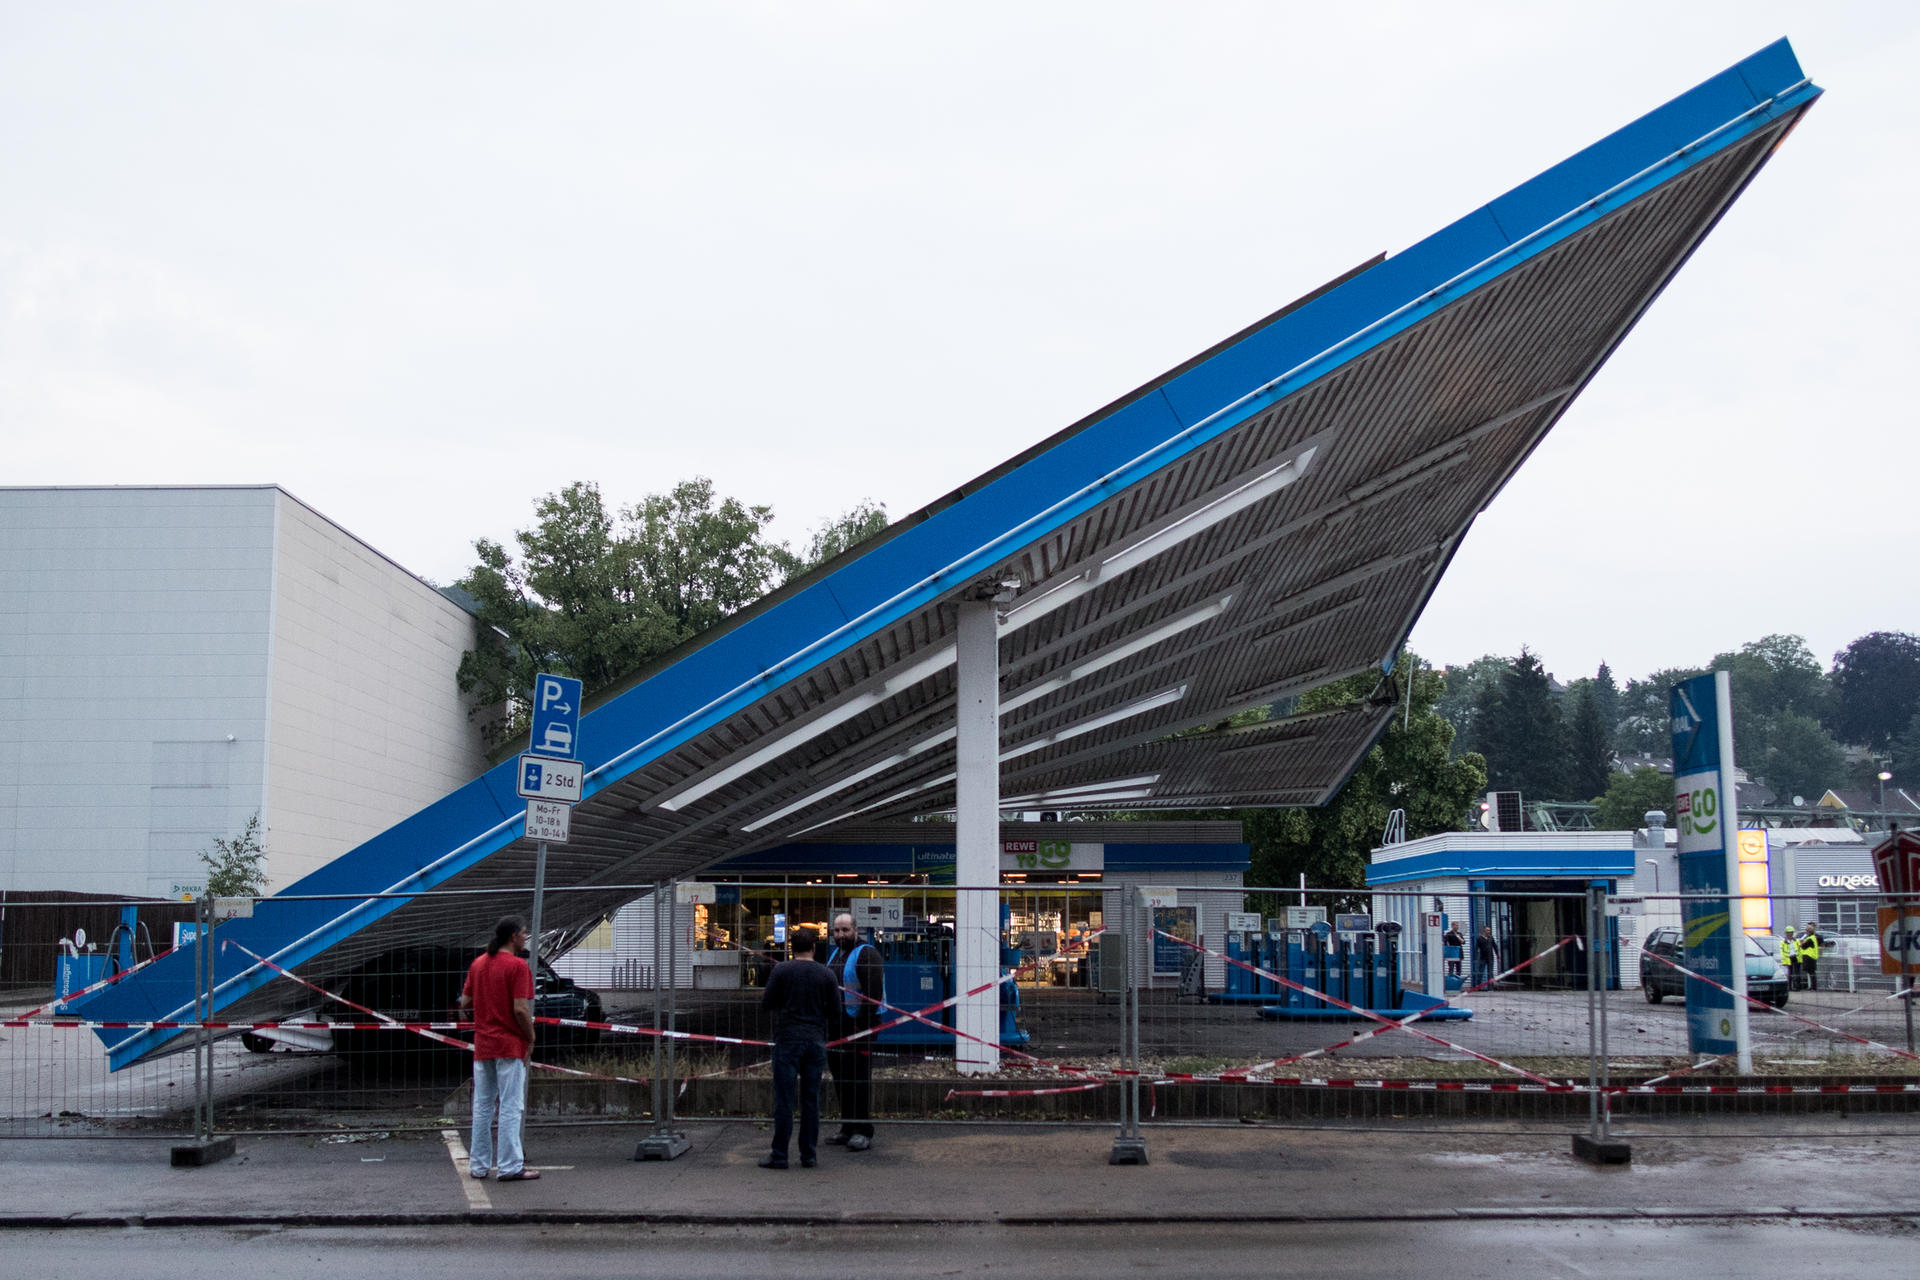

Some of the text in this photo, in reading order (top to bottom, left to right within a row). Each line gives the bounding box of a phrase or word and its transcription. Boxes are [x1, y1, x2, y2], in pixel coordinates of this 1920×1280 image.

[541, 680, 562, 711] P
[545, 773, 576, 788] 2 Std.
[536, 804, 560, 814] Mo-Fr
[1692, 788, 1716, 817] GO
[528, 826, 538, 835] Sa
[1005, 840, 1071, 858] REWE GO
[888, 909, 900, 920] 10
